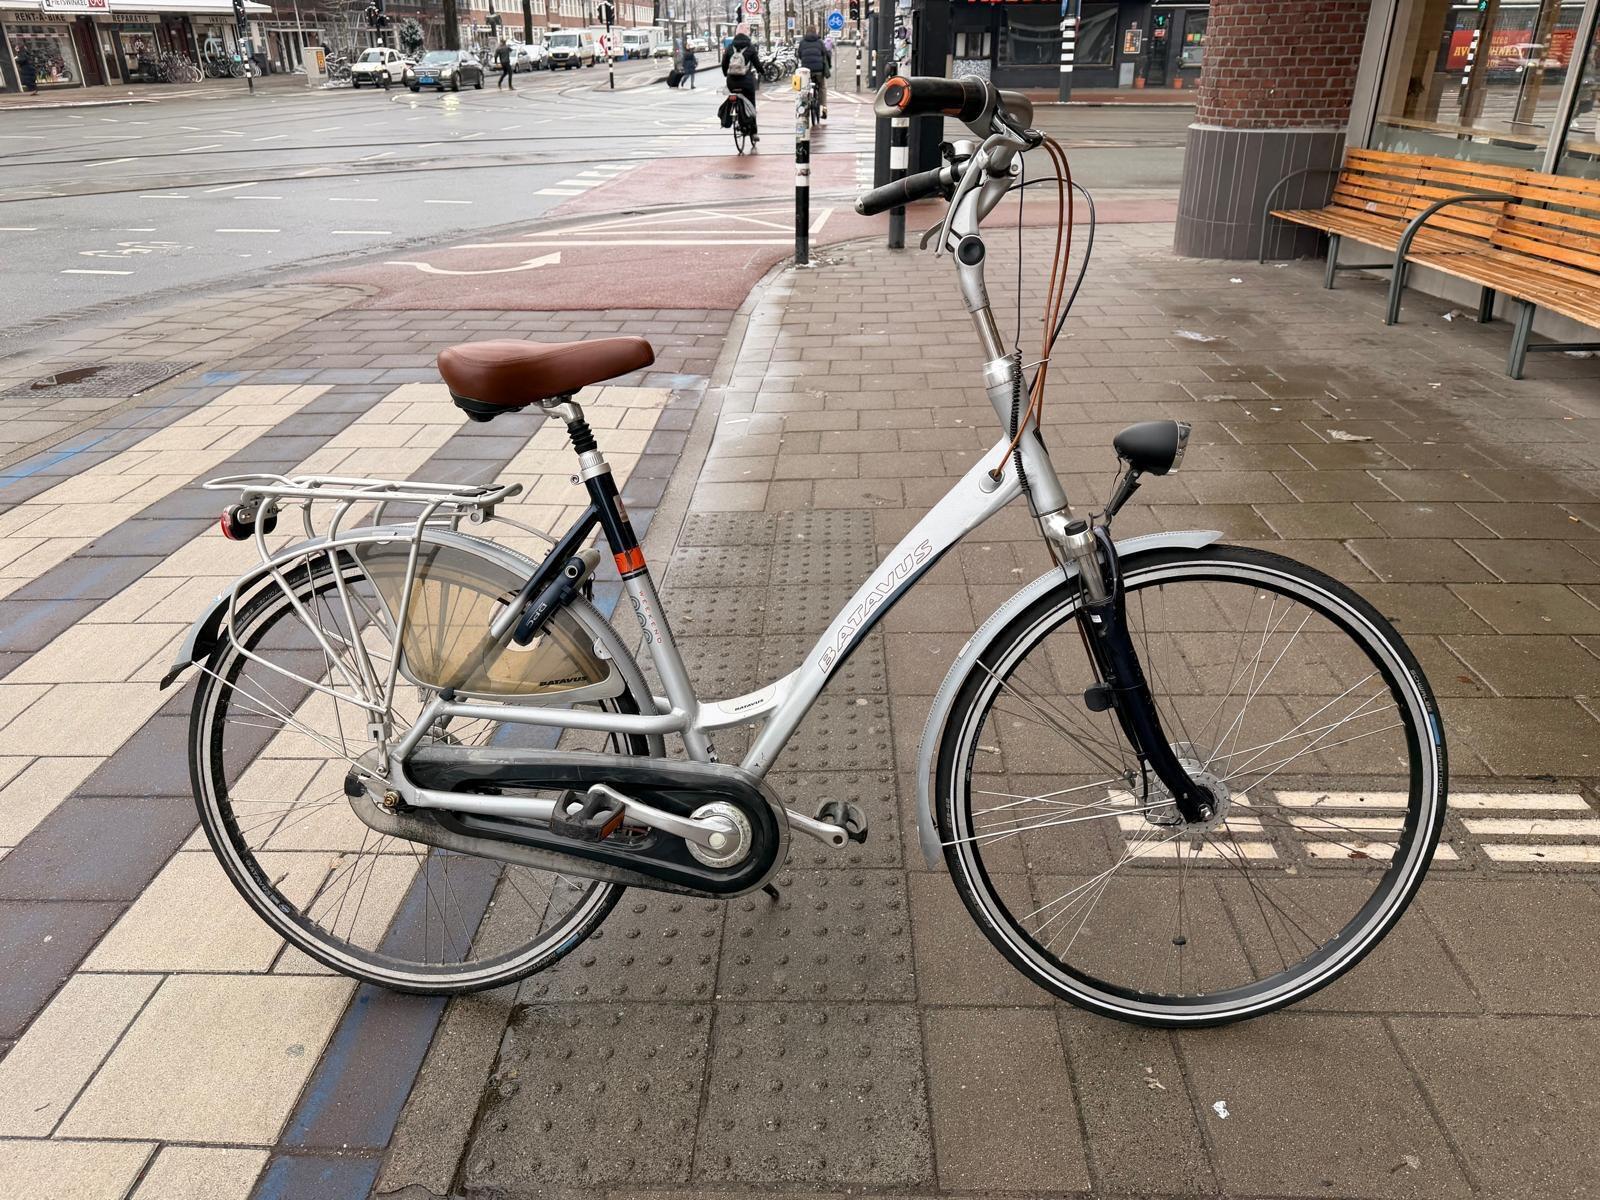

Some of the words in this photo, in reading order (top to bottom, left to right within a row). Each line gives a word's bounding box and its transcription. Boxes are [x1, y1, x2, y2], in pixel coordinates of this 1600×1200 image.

[748, 2, 758, 10] 30
[15, 13, 66, 21] RENT-A-BIKE
[112, 14, 149, 23] REPARATIE
[818, 539, 933, 674] BATAVUS
[538, 676, 588, 686] BATAVUS
[1409, 669, 1432, 712] SCHWALBE
[735, 699, 763, 711] BATAVUS
